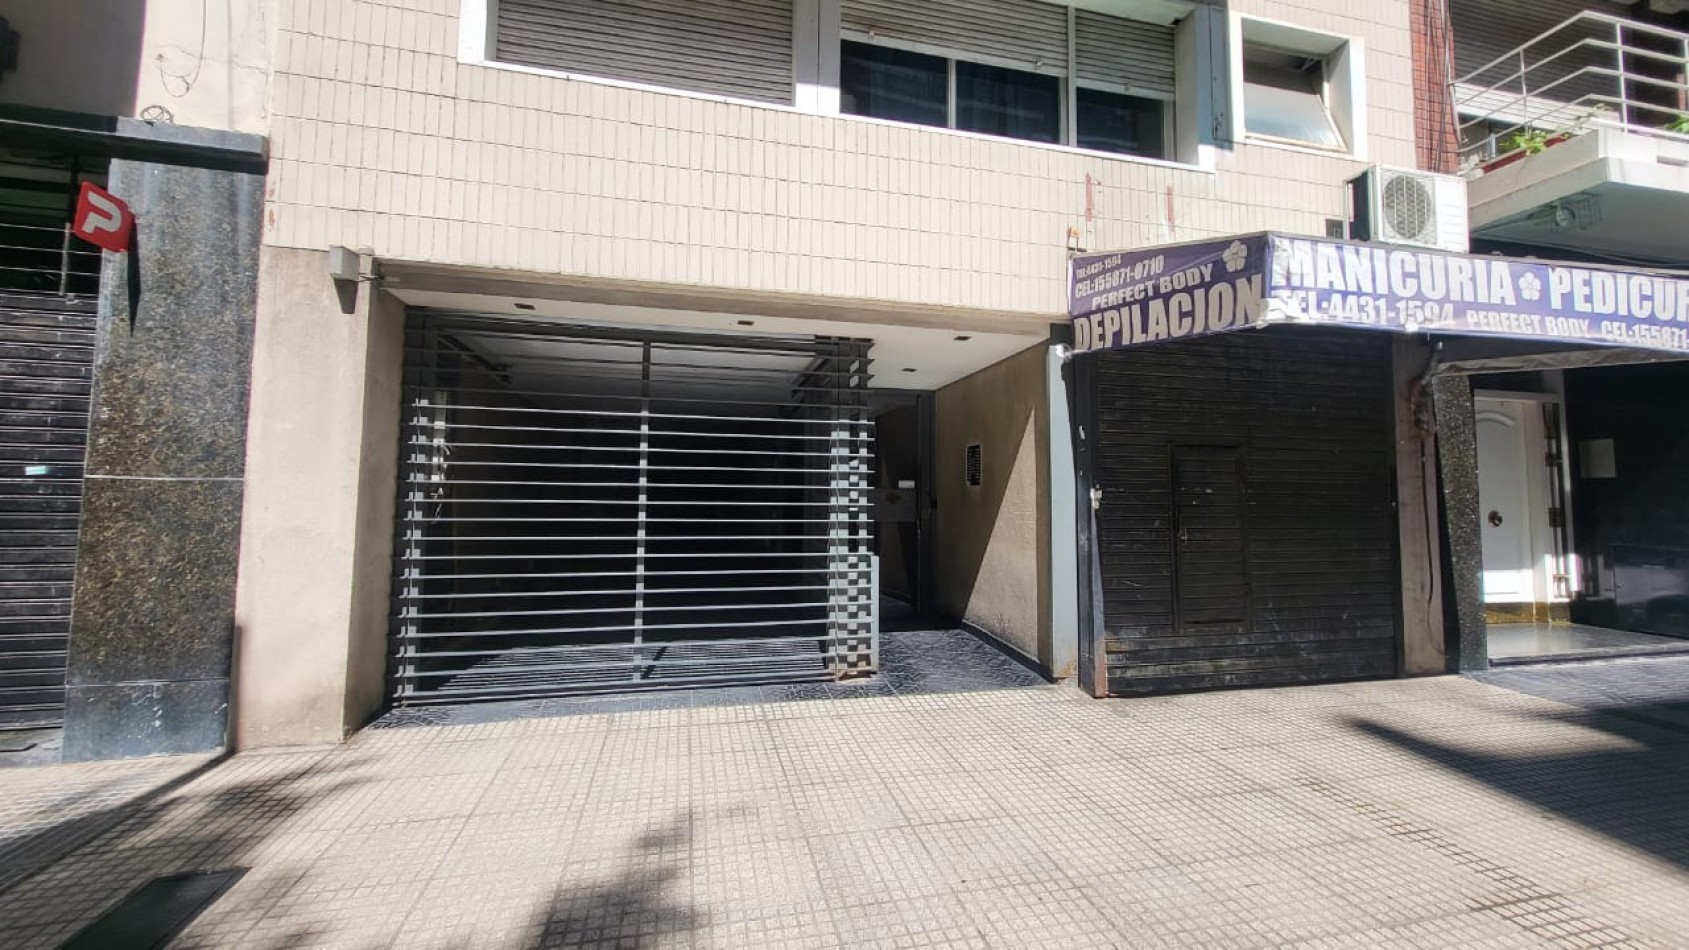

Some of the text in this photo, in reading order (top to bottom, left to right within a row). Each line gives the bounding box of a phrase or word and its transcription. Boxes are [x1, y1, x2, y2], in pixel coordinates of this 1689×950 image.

[1092, 263, 1214, 311] PERFECT BODY
[1271, 237, 1516, 306] MANICURIA
[1073, 274, 1264, 351] DEPILACION
[1466, 309, 1543, 336] PERFECT
[1544, 316, 1590, 339] BODY
